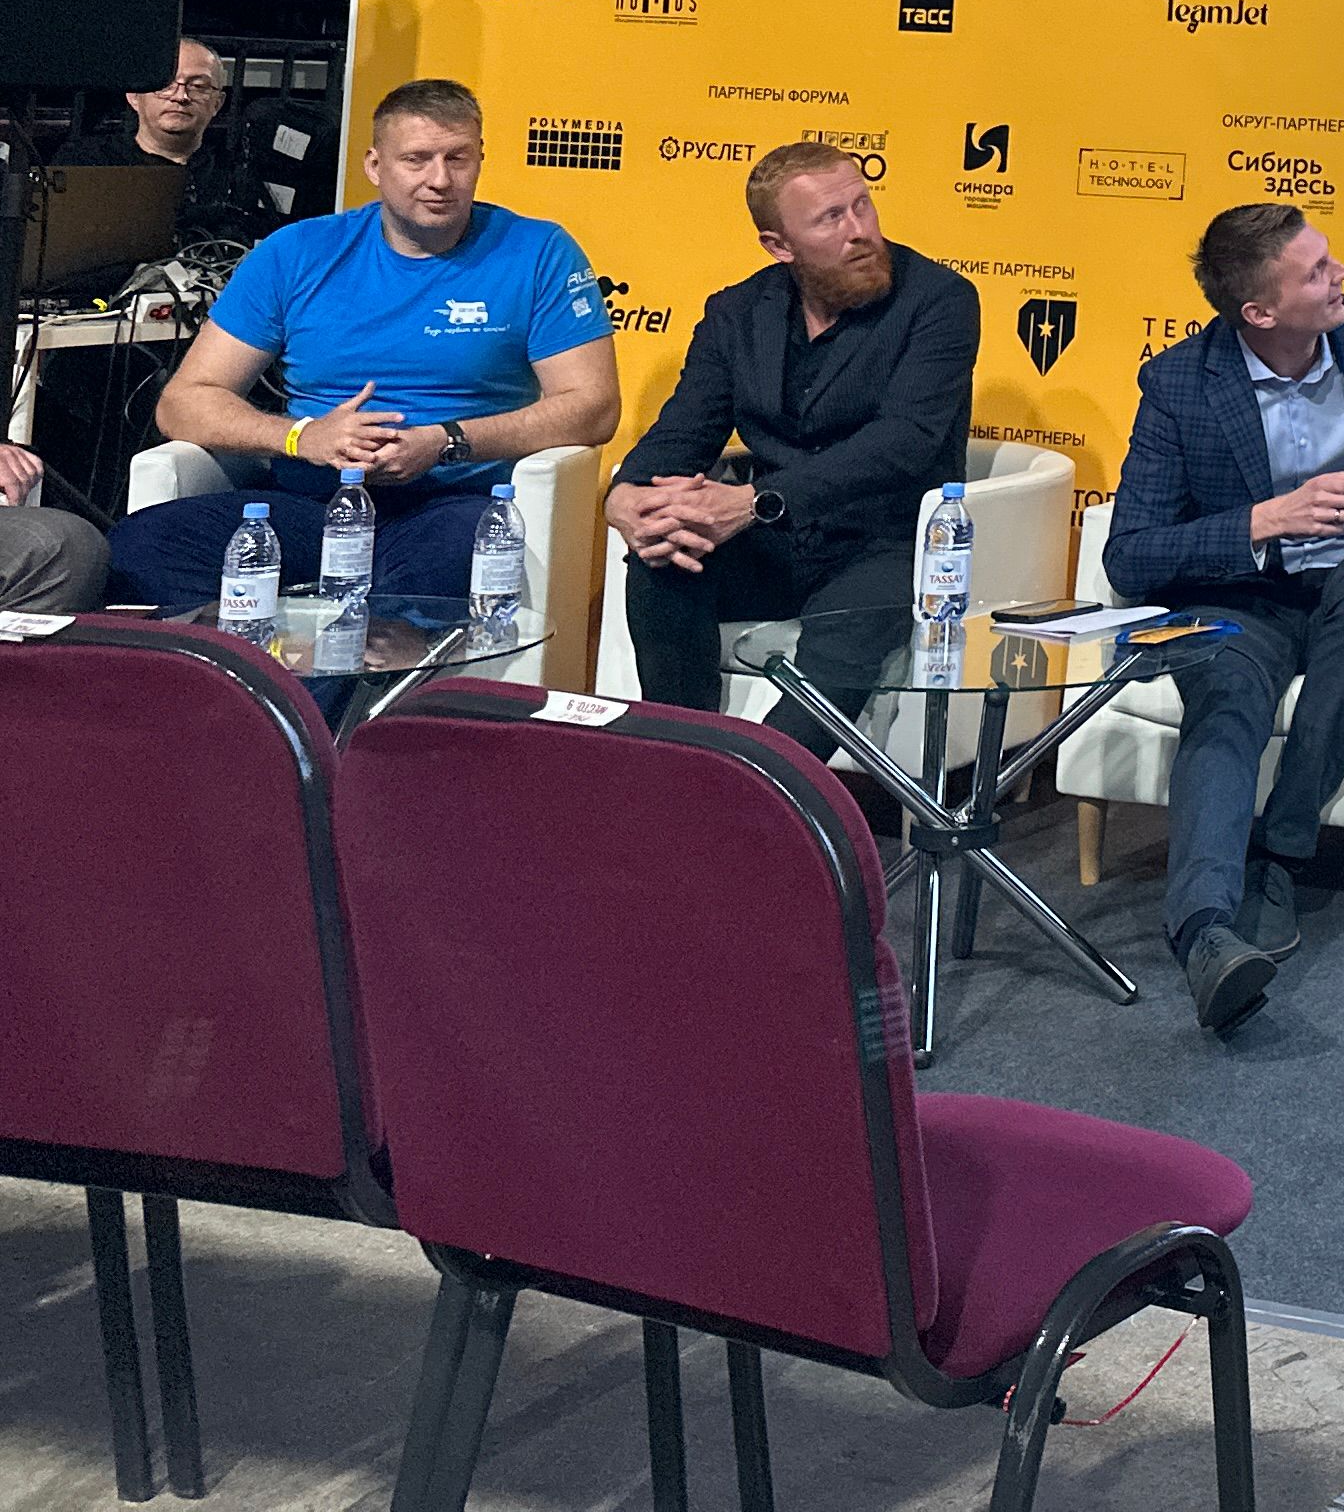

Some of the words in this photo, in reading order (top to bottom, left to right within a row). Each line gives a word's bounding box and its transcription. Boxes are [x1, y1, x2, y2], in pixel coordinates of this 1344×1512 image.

[708, 85, 784, 102] ПАРТНЕРЫ
[788, 88, 850, 105] ФОРУМА
[529, 117, 624, 131] POLYMEDIA
[682, 141, 756, 162] РУСЛЕТ
[1228, 150, 1322, 179] Сибирь
[954, 182, 1013, 197] синара
[1089, 175, 1172, 189] TECHNOLOGY
[1264, 177, 1335, 197] здесь
[993, 263, 1074, 280] ПАРТНЕРЫ
[1004, 428, 1085, 447] ПАРТНЕРЫ
[929, 575, 964, 584] TASSAY
[223, 598, 260, 608] TASSAY
